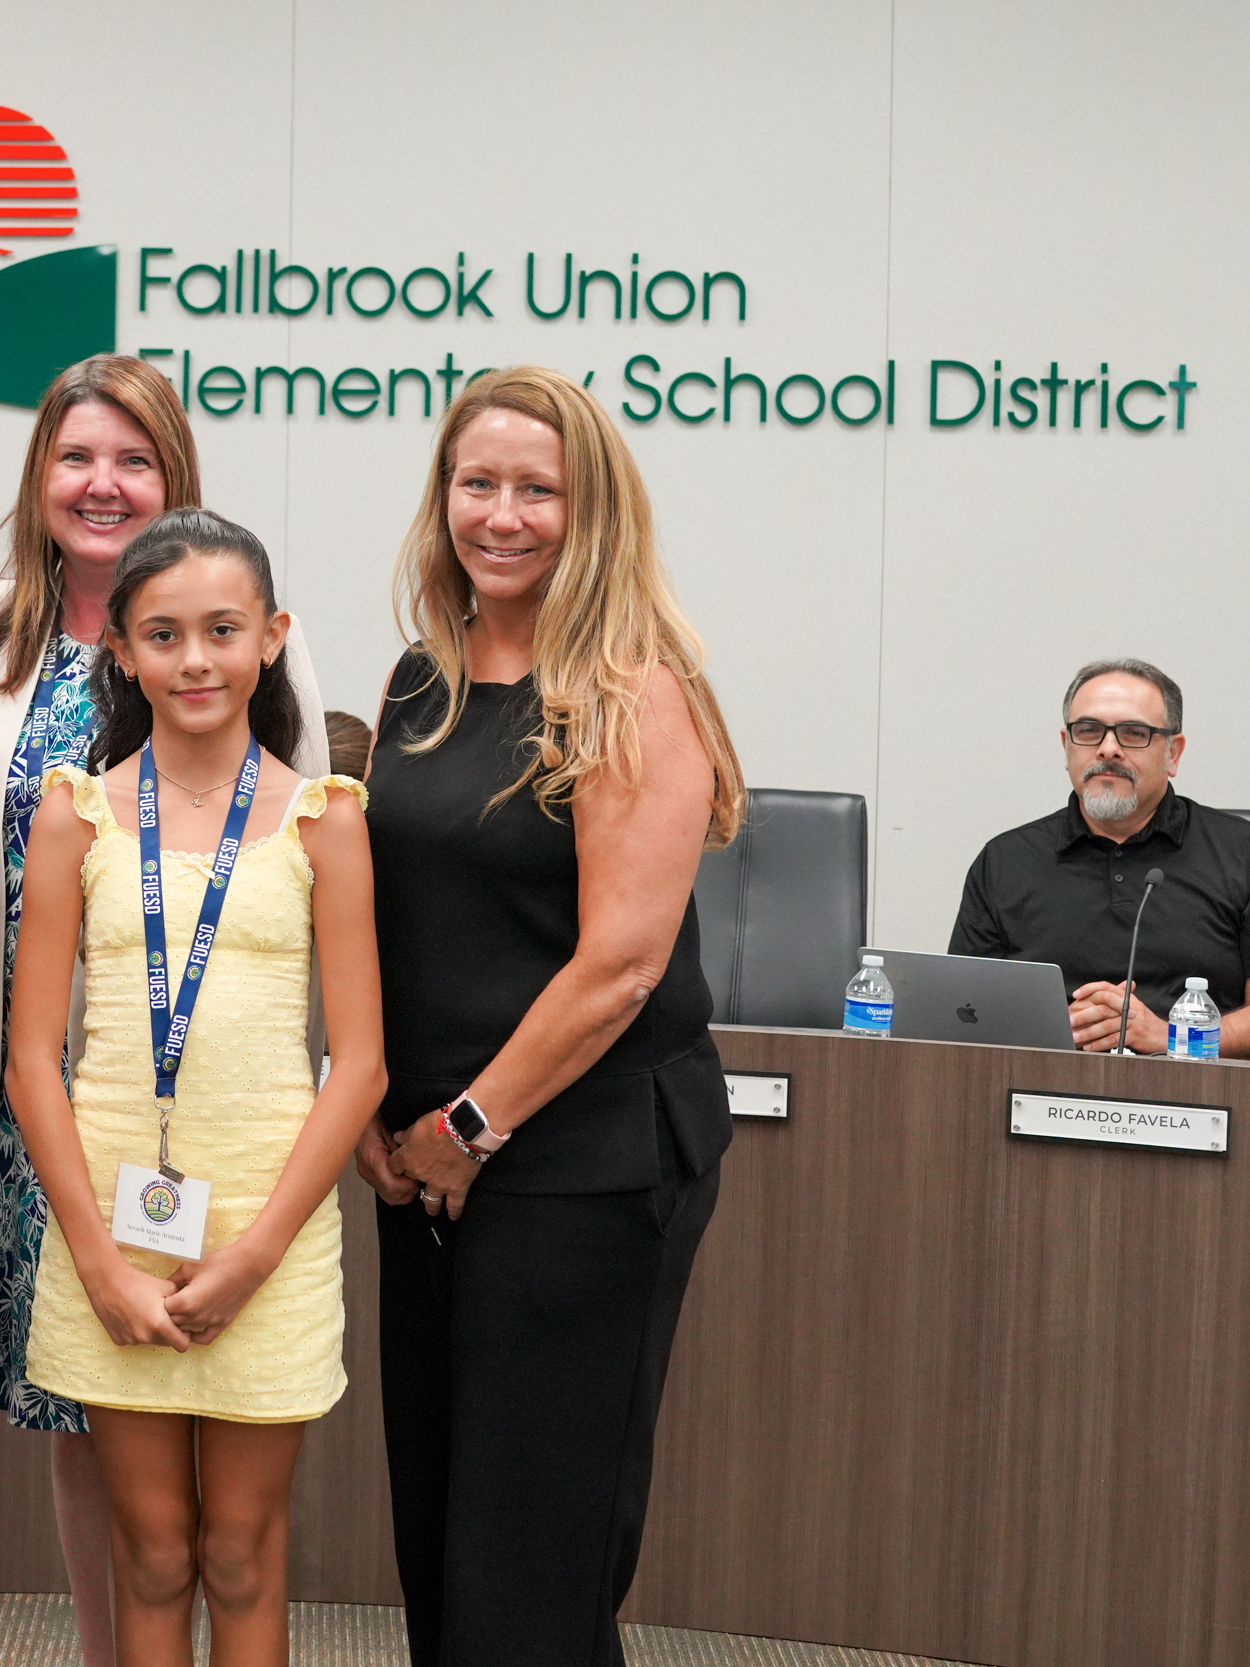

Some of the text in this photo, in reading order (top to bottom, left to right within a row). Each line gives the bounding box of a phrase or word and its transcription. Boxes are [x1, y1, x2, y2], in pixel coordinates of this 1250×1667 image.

[138, 246, 747, 322] Fallbrook Union
[138, 347, 1198, 434] lement School District
[42, 637, 58, 669] FUESD
[31, 706, 49, 738] FUESD
[62, 734, 88, 766] FUESD
[28, 775, 41, 807] UESD
[237, 758, 259, 795] FUESD
[139, 791, 156, 829] FUESD
[214, 837, 239, 875] FUESD
[143, 874, 161, 915] FUESD
[190, 923, 215, 965] FUESD
[149, 968, 167, 1010] FUESD
[165, 1014, 189, 1057] FUESD
[1048, 1107, 1191, 1129] RICARDO FAVELA
[1100, 1126, 1137, 1135] CLERK
[139, 1179, 181, 1210] GROWING GREATNESS
[146, 1228, 161, 1237] Marie
[161, 1232, 186, 1242] Armenta
